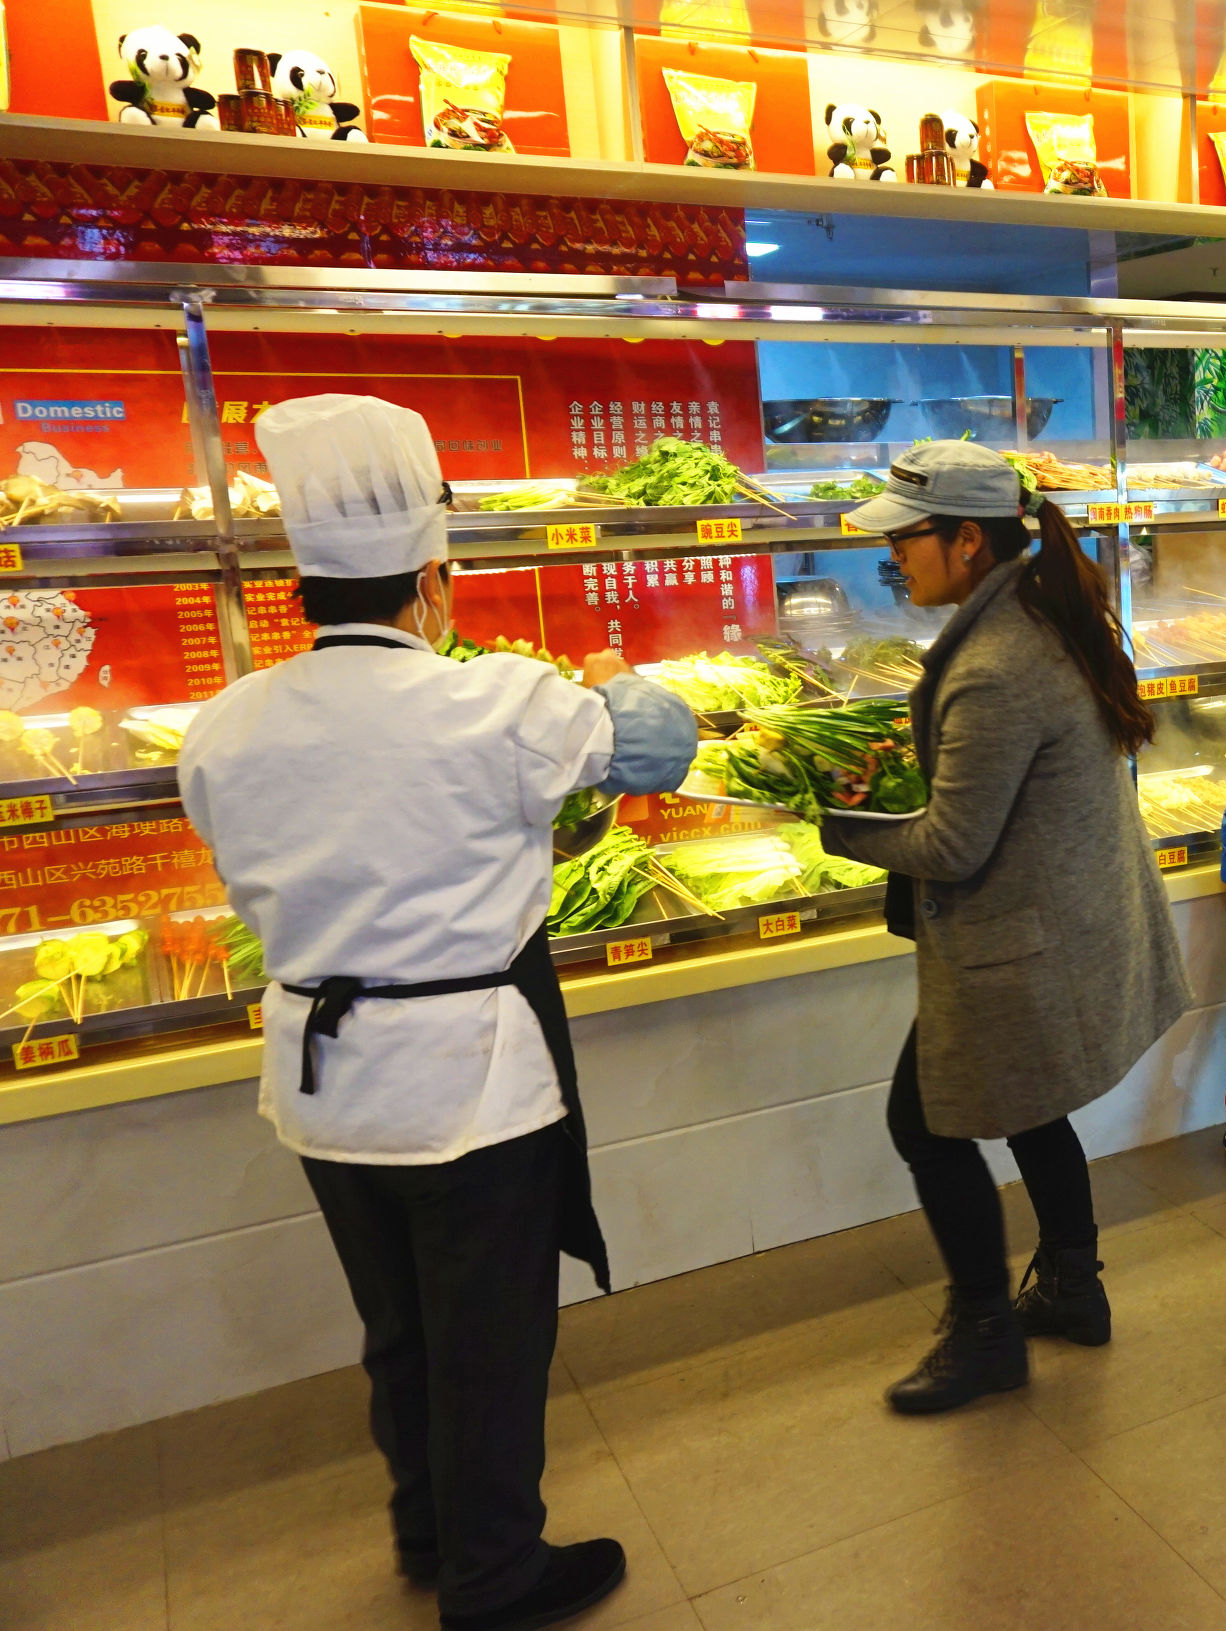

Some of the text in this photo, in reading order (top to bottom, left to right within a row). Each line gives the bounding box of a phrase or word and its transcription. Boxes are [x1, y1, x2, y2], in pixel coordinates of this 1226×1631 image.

[16, 402, 125, 419] Domestic
[42, 422, 110, 433] Business
[551, 525, 593, 545] 小米菜
[701, 521, 739, 540] 豌豆尖
[682, 557, 697, 585] 分享
[700, 556, 715, 583] 照顾
[175, 596, 211, 605] 2004年
[177, 609, 214, 618] 2005年
[179, 623, 215, 632] 2006年
[181, 636, 218, 645] 2007年
[183, 649, 219, 659] 2008年
[185, 663, 221, 672] 2009年
[187, 676, 223, 686] 2010年
[1169, 677, 1196, 694] 鱼豆腐
[190, 689, 221, 699] 2011
[660, 803, 708, 820] YUAN
[762, 915, 798, 935] 大白菜
[610, 940, 649, 962] 青笋尖
